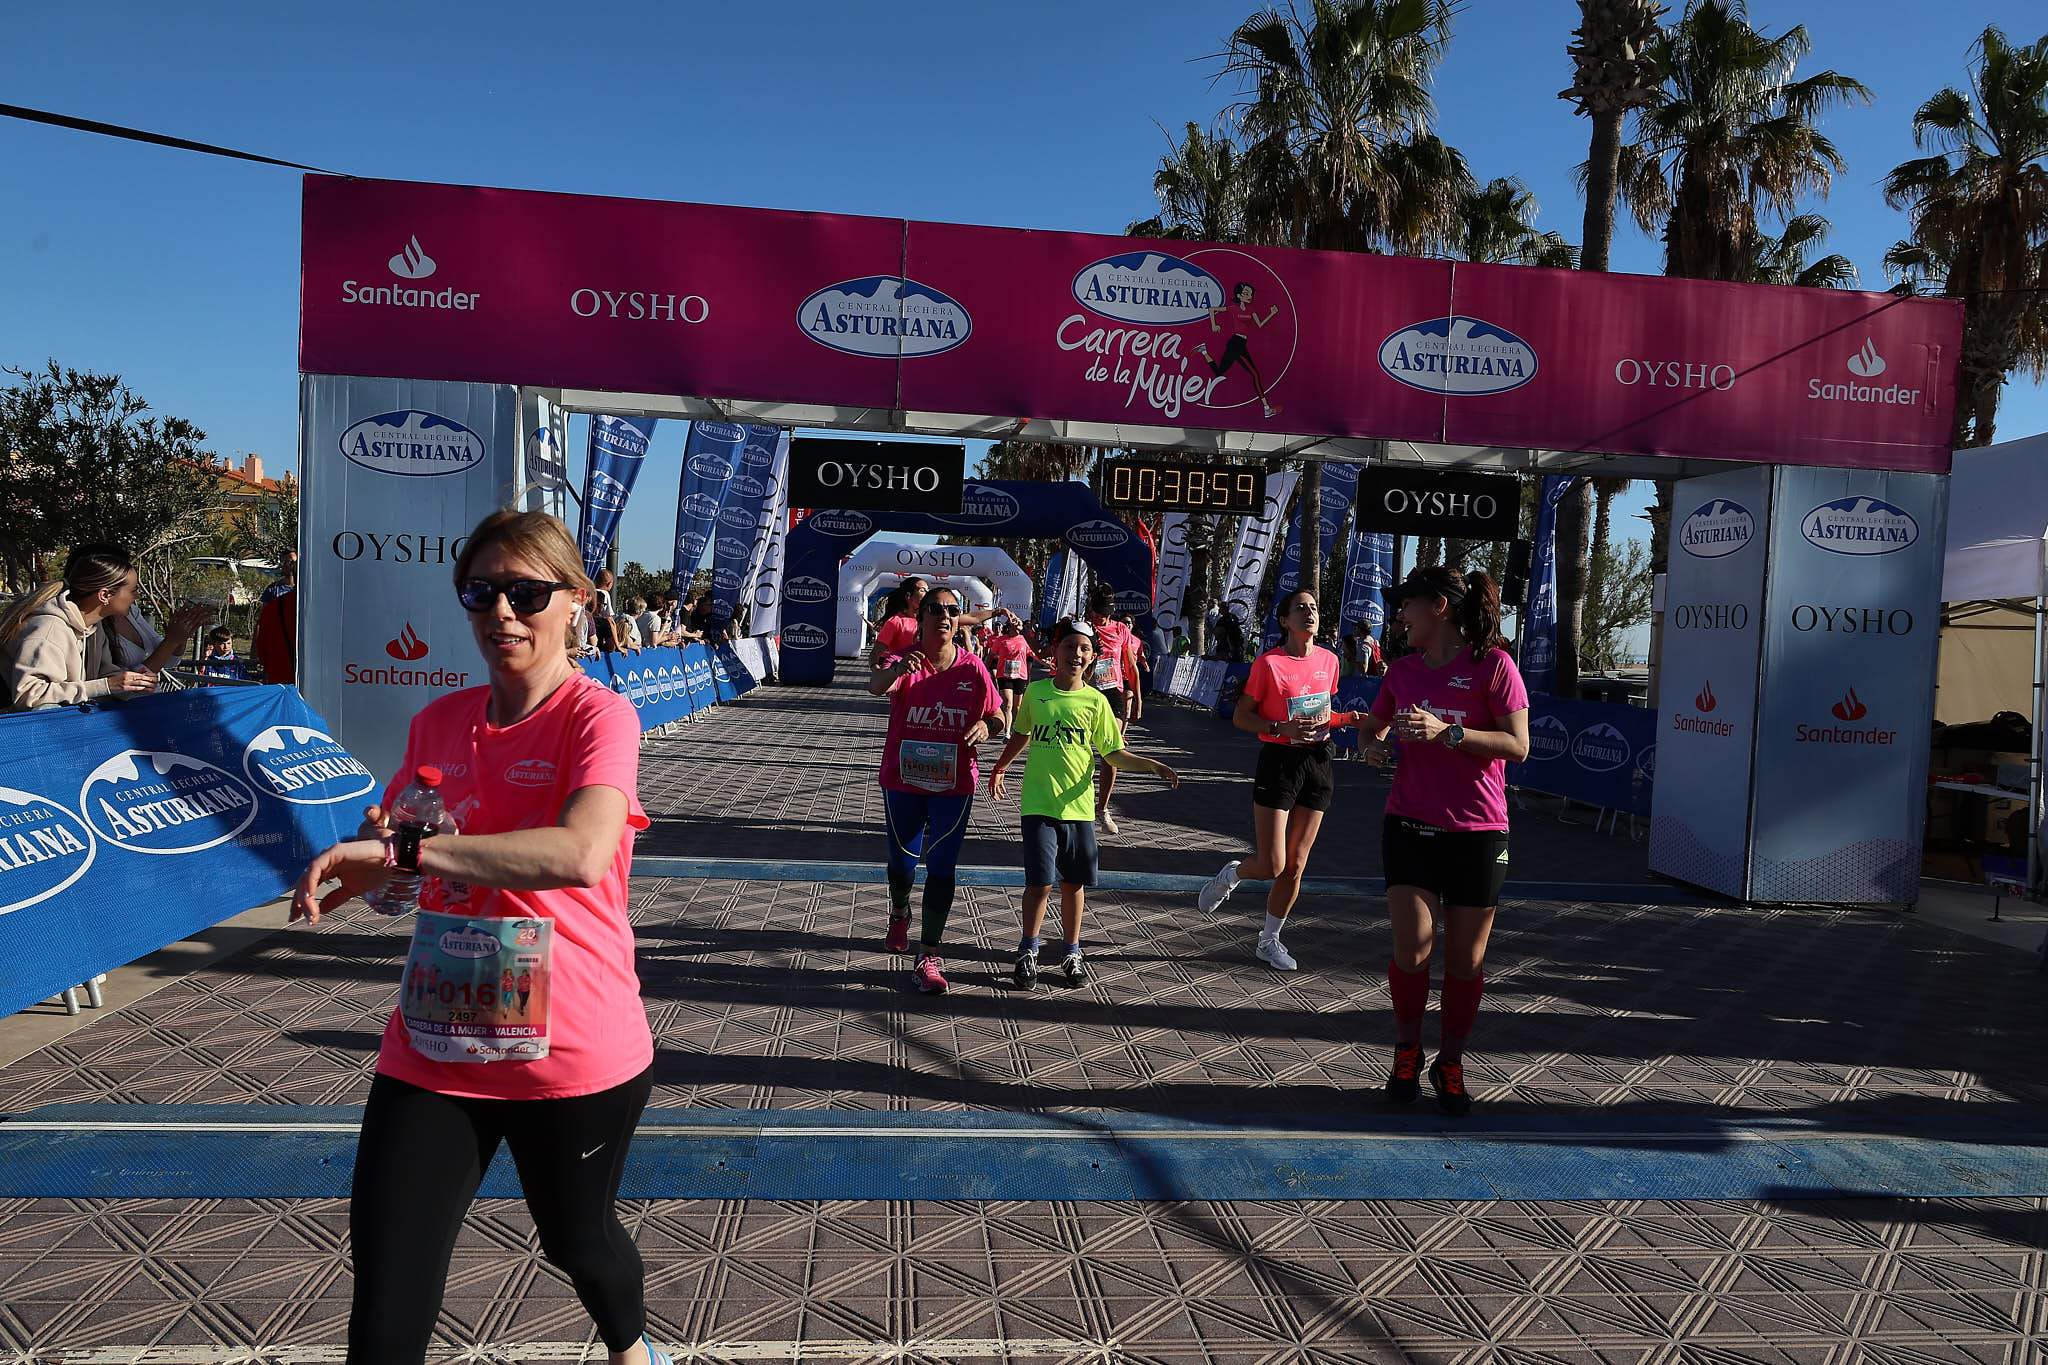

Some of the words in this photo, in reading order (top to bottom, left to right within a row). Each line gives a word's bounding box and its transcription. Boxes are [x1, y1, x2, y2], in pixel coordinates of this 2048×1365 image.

[1083, 273, 1212, 310] ASTURIANA
[1108, 273, 1156, 285] CENTRAL
[1160, 277, 1210, 288] LECHERA
[342, 280, 480, 311] Santander
[570, 288, 709, 324] OYSHO
[838, 300, 893, 313] CENTRAL
[897, 304, 954, 317] LECHERA
[810, 300, 958, 341] ASTURIANA
[1056, 314, 1183, 360] Carrera
[1416, 341, 1465, 352] CENTRAL
[1469, 343, 1522, 356] LECHERA
[1389, 340, 1526, 379] ASTURIANA
[1085, 356, 1109, 382] de
[1113, 356, 1131, 384] la
[1123, 356, 1227, 419] Mujer
[1615, 358, 1738, 392] OYSHO
[1808, 378, 1921, 406] Santander
[350, 431, 474, 463] ASTURIANA
[373, 431, 419, 440] CENTRAL
[423, 433, 470, 443] LECHERA
[817, 460, 940, 493] OYSHO
[1114, 467, 1254, 506] 00:38:59
[1383, 487, 1498, 520] OYSHO
[1683, 522, 1749, 546] ASTURIANA
[1808, 515, 1910, 543] ASTURIANA
[896, 549, 975, 569] OYSHO
[786, 585, 829, 598] ASTURIANA
[1675, 603, 1748, 631] OYSHO
[1791, 605, 1913, 636] OYSHO
[783, 629, 825, 643] ASTURIANA
[345, 664, 469, 688] Santander
[1673, 713, 1734, 737] Santander
[1795, 724, 1897, 745] Santander
[269, 750, 313, 766] CENTRAL
[1575, 738, 1624, 763] ASTURIANA
[115, 783, 169, 801] CENTRAL
[171, 772, 222, 791] LECHERA
[257, 756, 371, 794] ASTURIANA
[99, 784, 252, 841] ASTURIANA
[441, 936, 497, 953] ASTURIANA
[445, 1024, 456, 1034] LA
[458, 1025, 487, 1035] MUJER
[495, 1026, 538, 1036] VALENCIA
[448, 1011, 477, 1022] 2497
[480, 1045, 530, 1055] Santander
